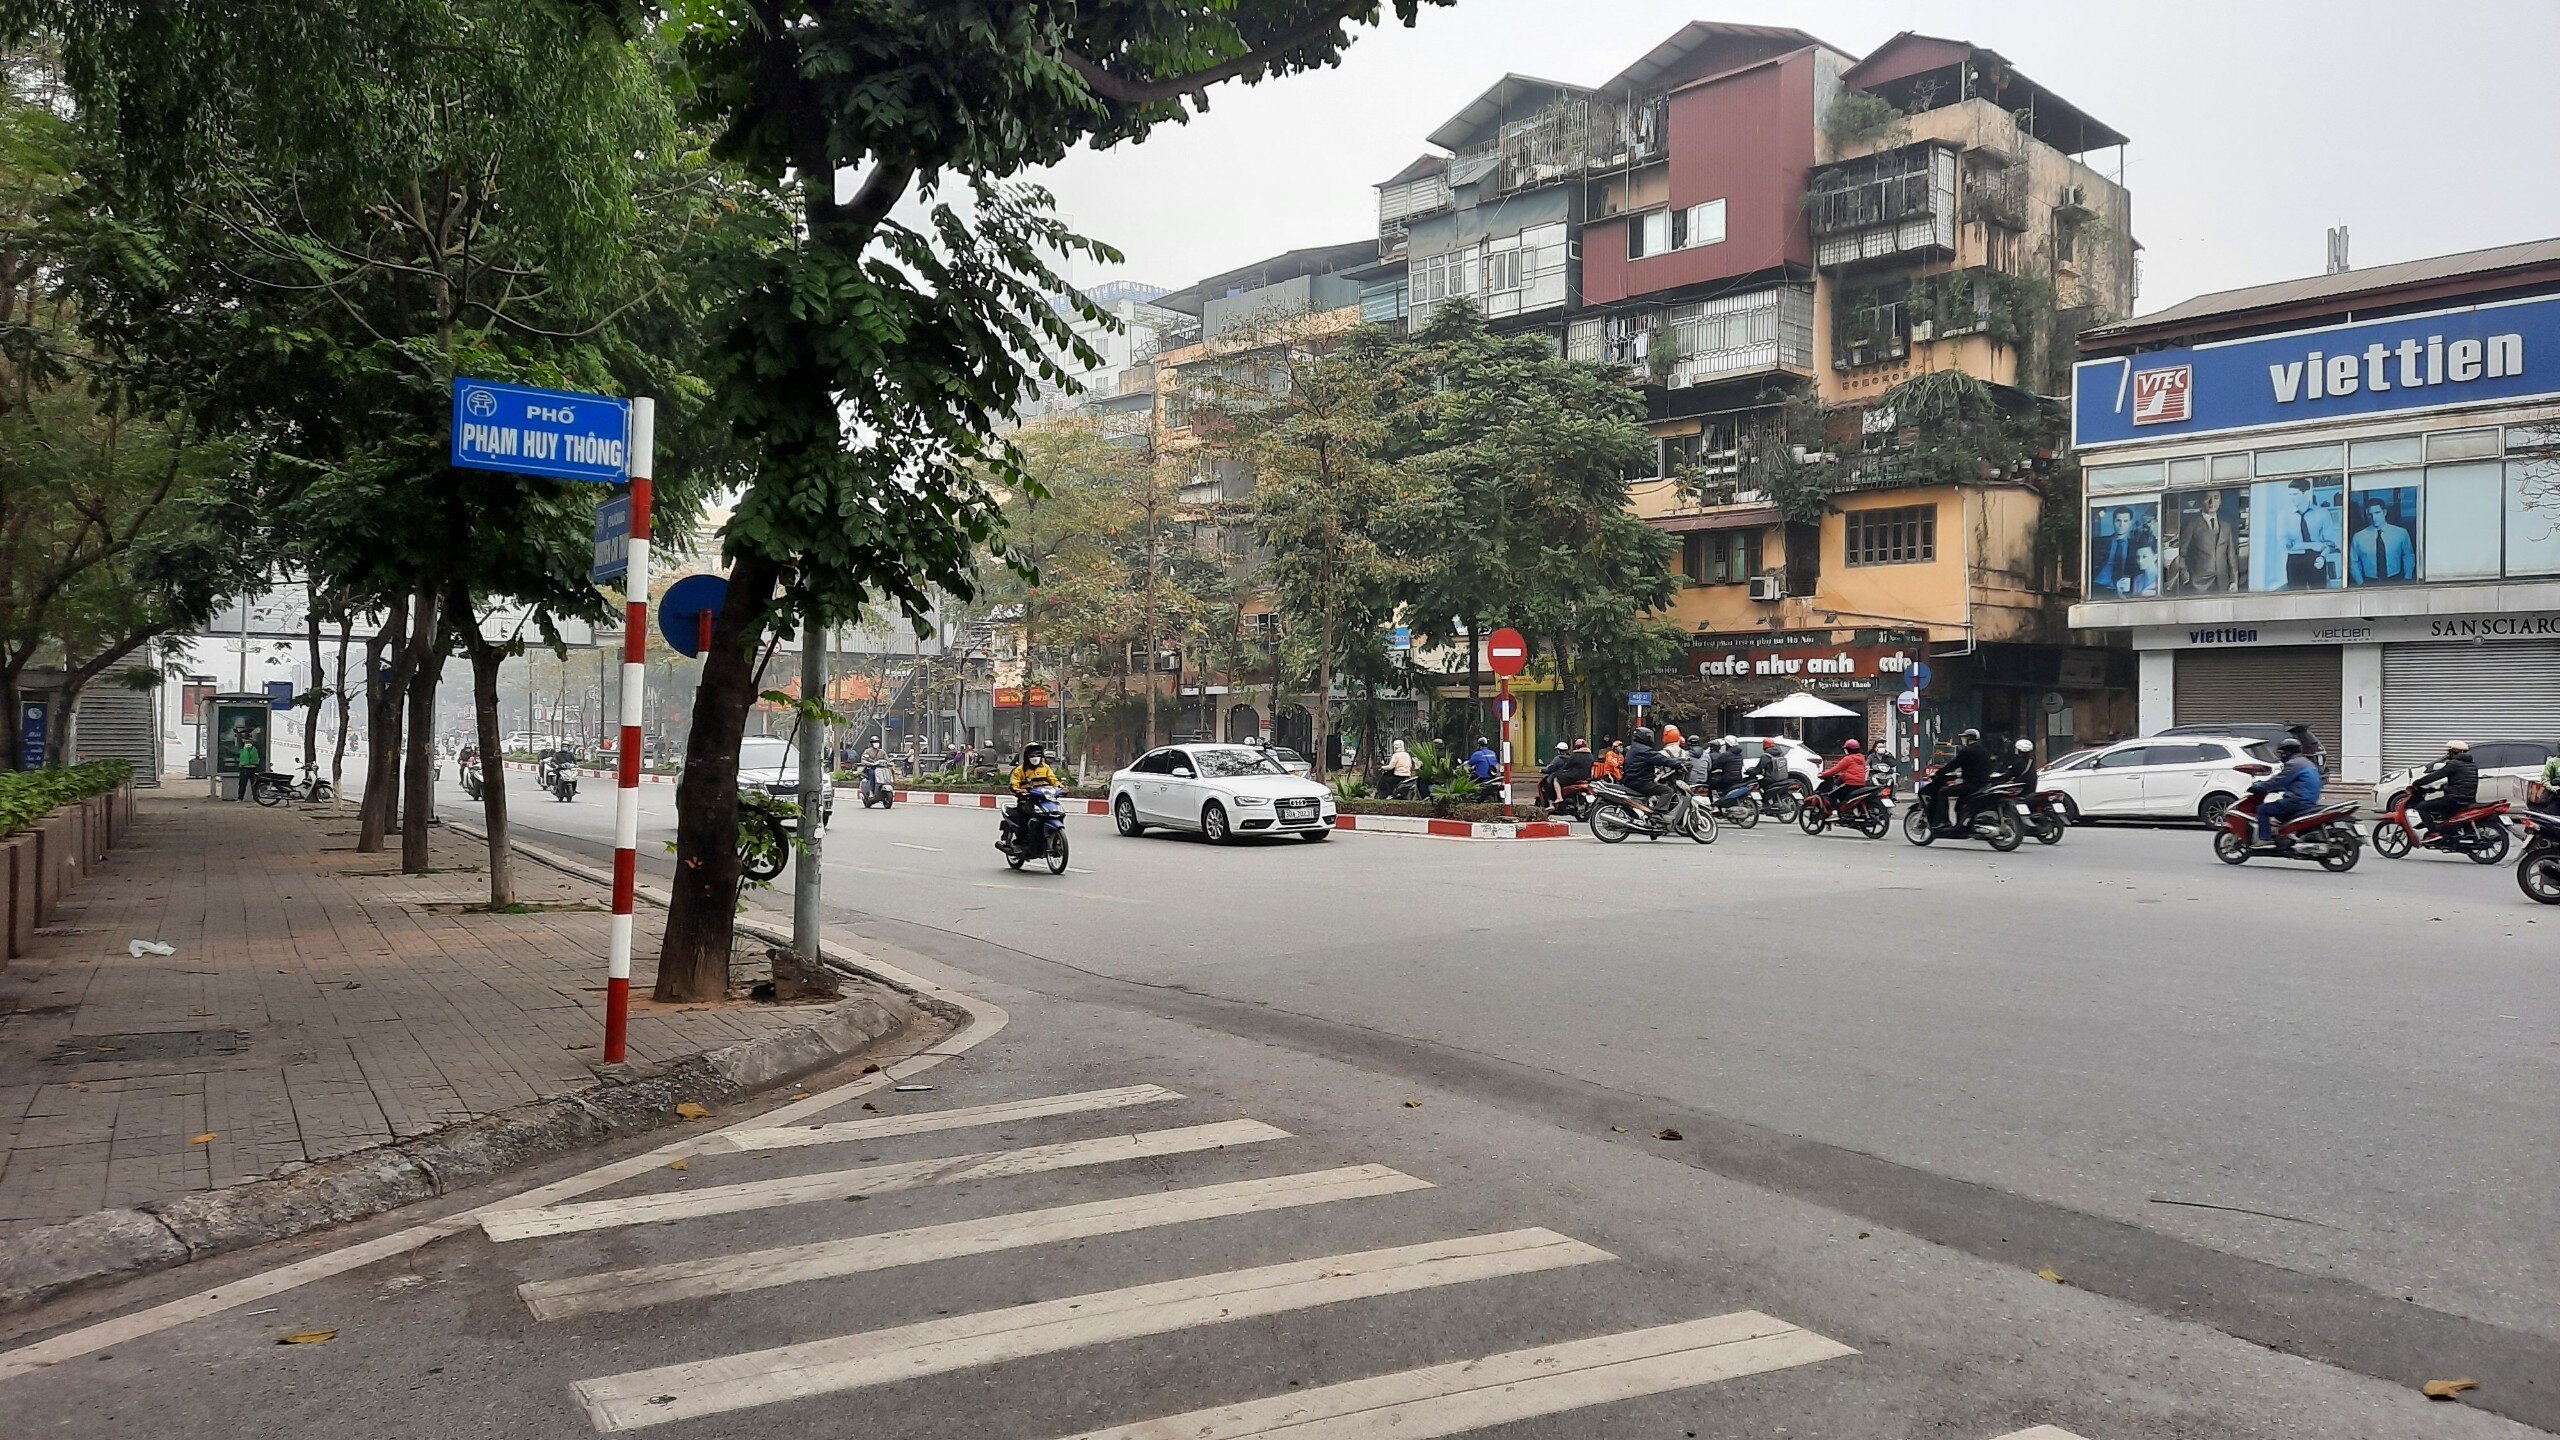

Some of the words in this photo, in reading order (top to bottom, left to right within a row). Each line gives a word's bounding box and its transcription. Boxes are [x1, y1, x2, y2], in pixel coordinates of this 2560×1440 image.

[2269, 334, 2523, 403] viettien
[2138, 369, 2187, 396] VTEC
[526, 405, 576, 424] PHỐ
[462, 422, 518, 459] PHẠM
[523, 429, 559, 460] HUY
[563, 431, 622, 467] THÔNG
[2189, 628, 2258, 643] viettien
[2312, 627, 2371, 639] viettien
[1700, 655, 1750, 676] cafe
[1755, 654, 1803, 675] như
[1807, 651, 1855, 674] anh
